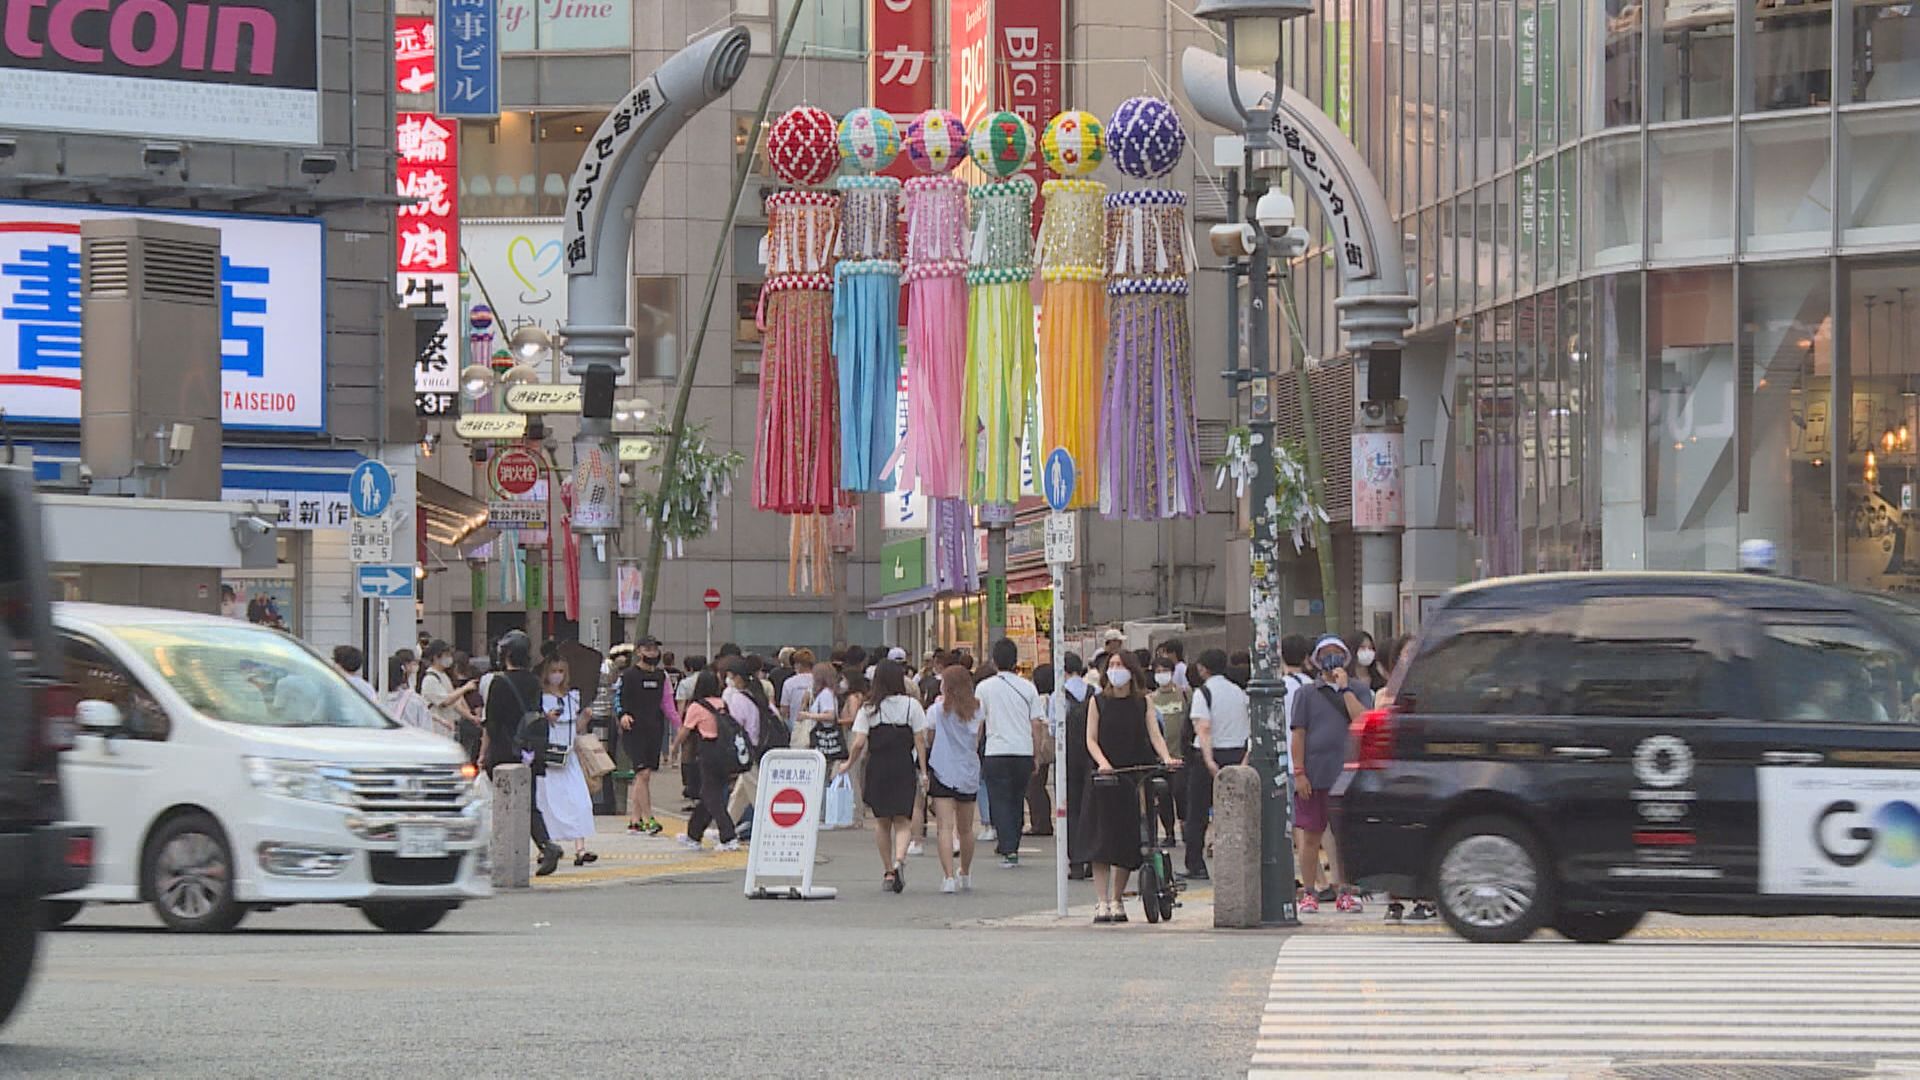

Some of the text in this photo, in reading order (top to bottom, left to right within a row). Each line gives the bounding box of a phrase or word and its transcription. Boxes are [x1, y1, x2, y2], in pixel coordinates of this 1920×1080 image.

[451, 0, 487, 101] 事ビル
[1004, 26, 1039, 98] BIG
[566, 88, 651, 269] 渋谷センター街
[223, 391, 296, 412] TAISEIDO
[500, 464, 535, 482] 消火栓
